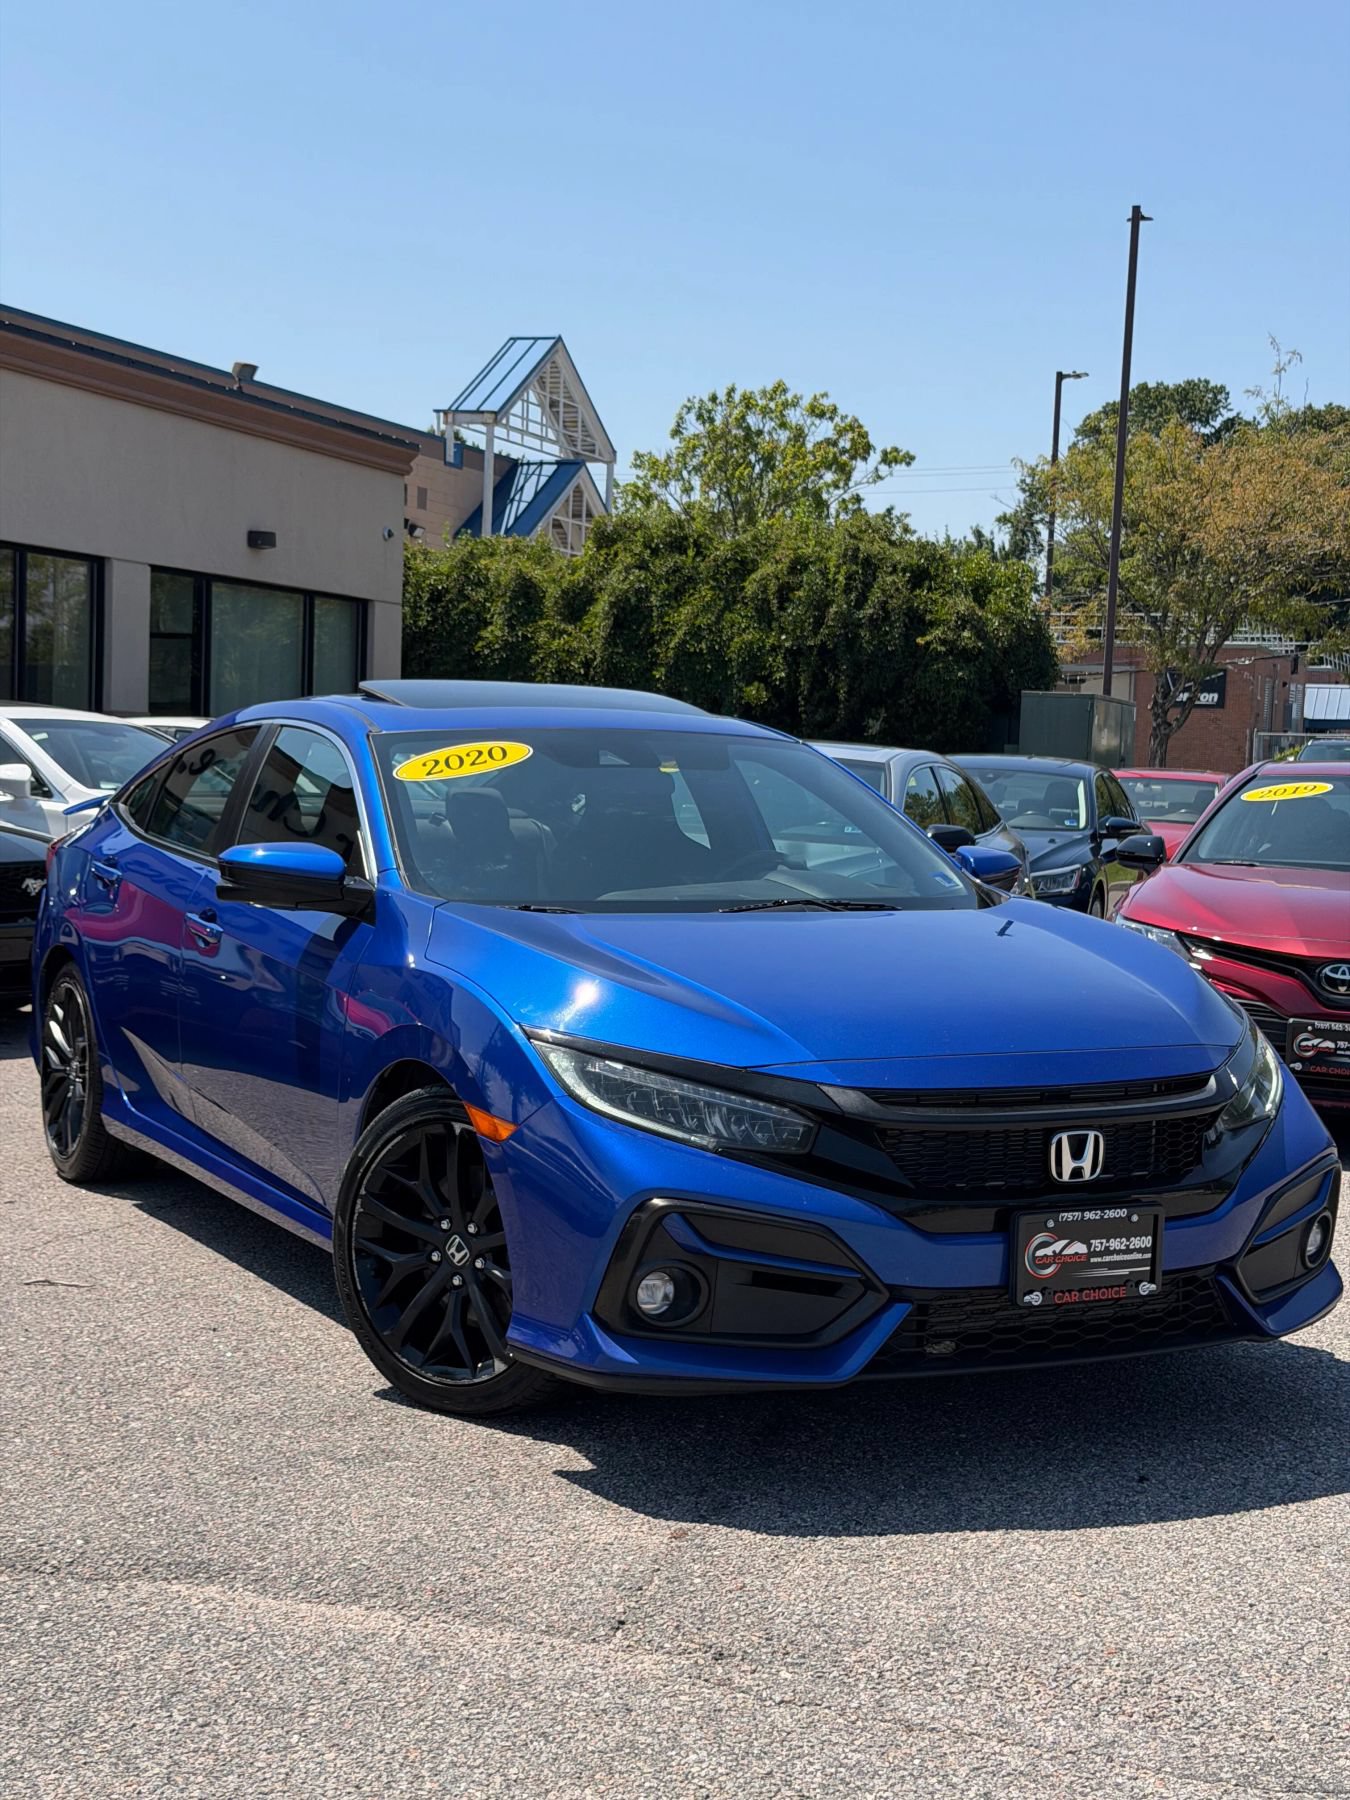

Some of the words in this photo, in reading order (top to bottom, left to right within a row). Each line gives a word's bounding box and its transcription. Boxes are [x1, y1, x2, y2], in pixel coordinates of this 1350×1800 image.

[1172, 692, 1219, 704] eron
[422, 745, 508, 777] 2020
[1258, 784, 1317, 799] 2019
[1059, 1212, 1082, 1222] (757)
[1083, 1208, 1128, 1220] 962-2600
[1090, 1235, 1152, 1252] 757-962-2600
[1035, 1256, 1055, 1265] CAR
[1055, 1254, 1088, 1263] CHOICE
[1054, 1291, 1080, 1304] CAR
[1082, 1286, 1127, 1301] CHOICE
